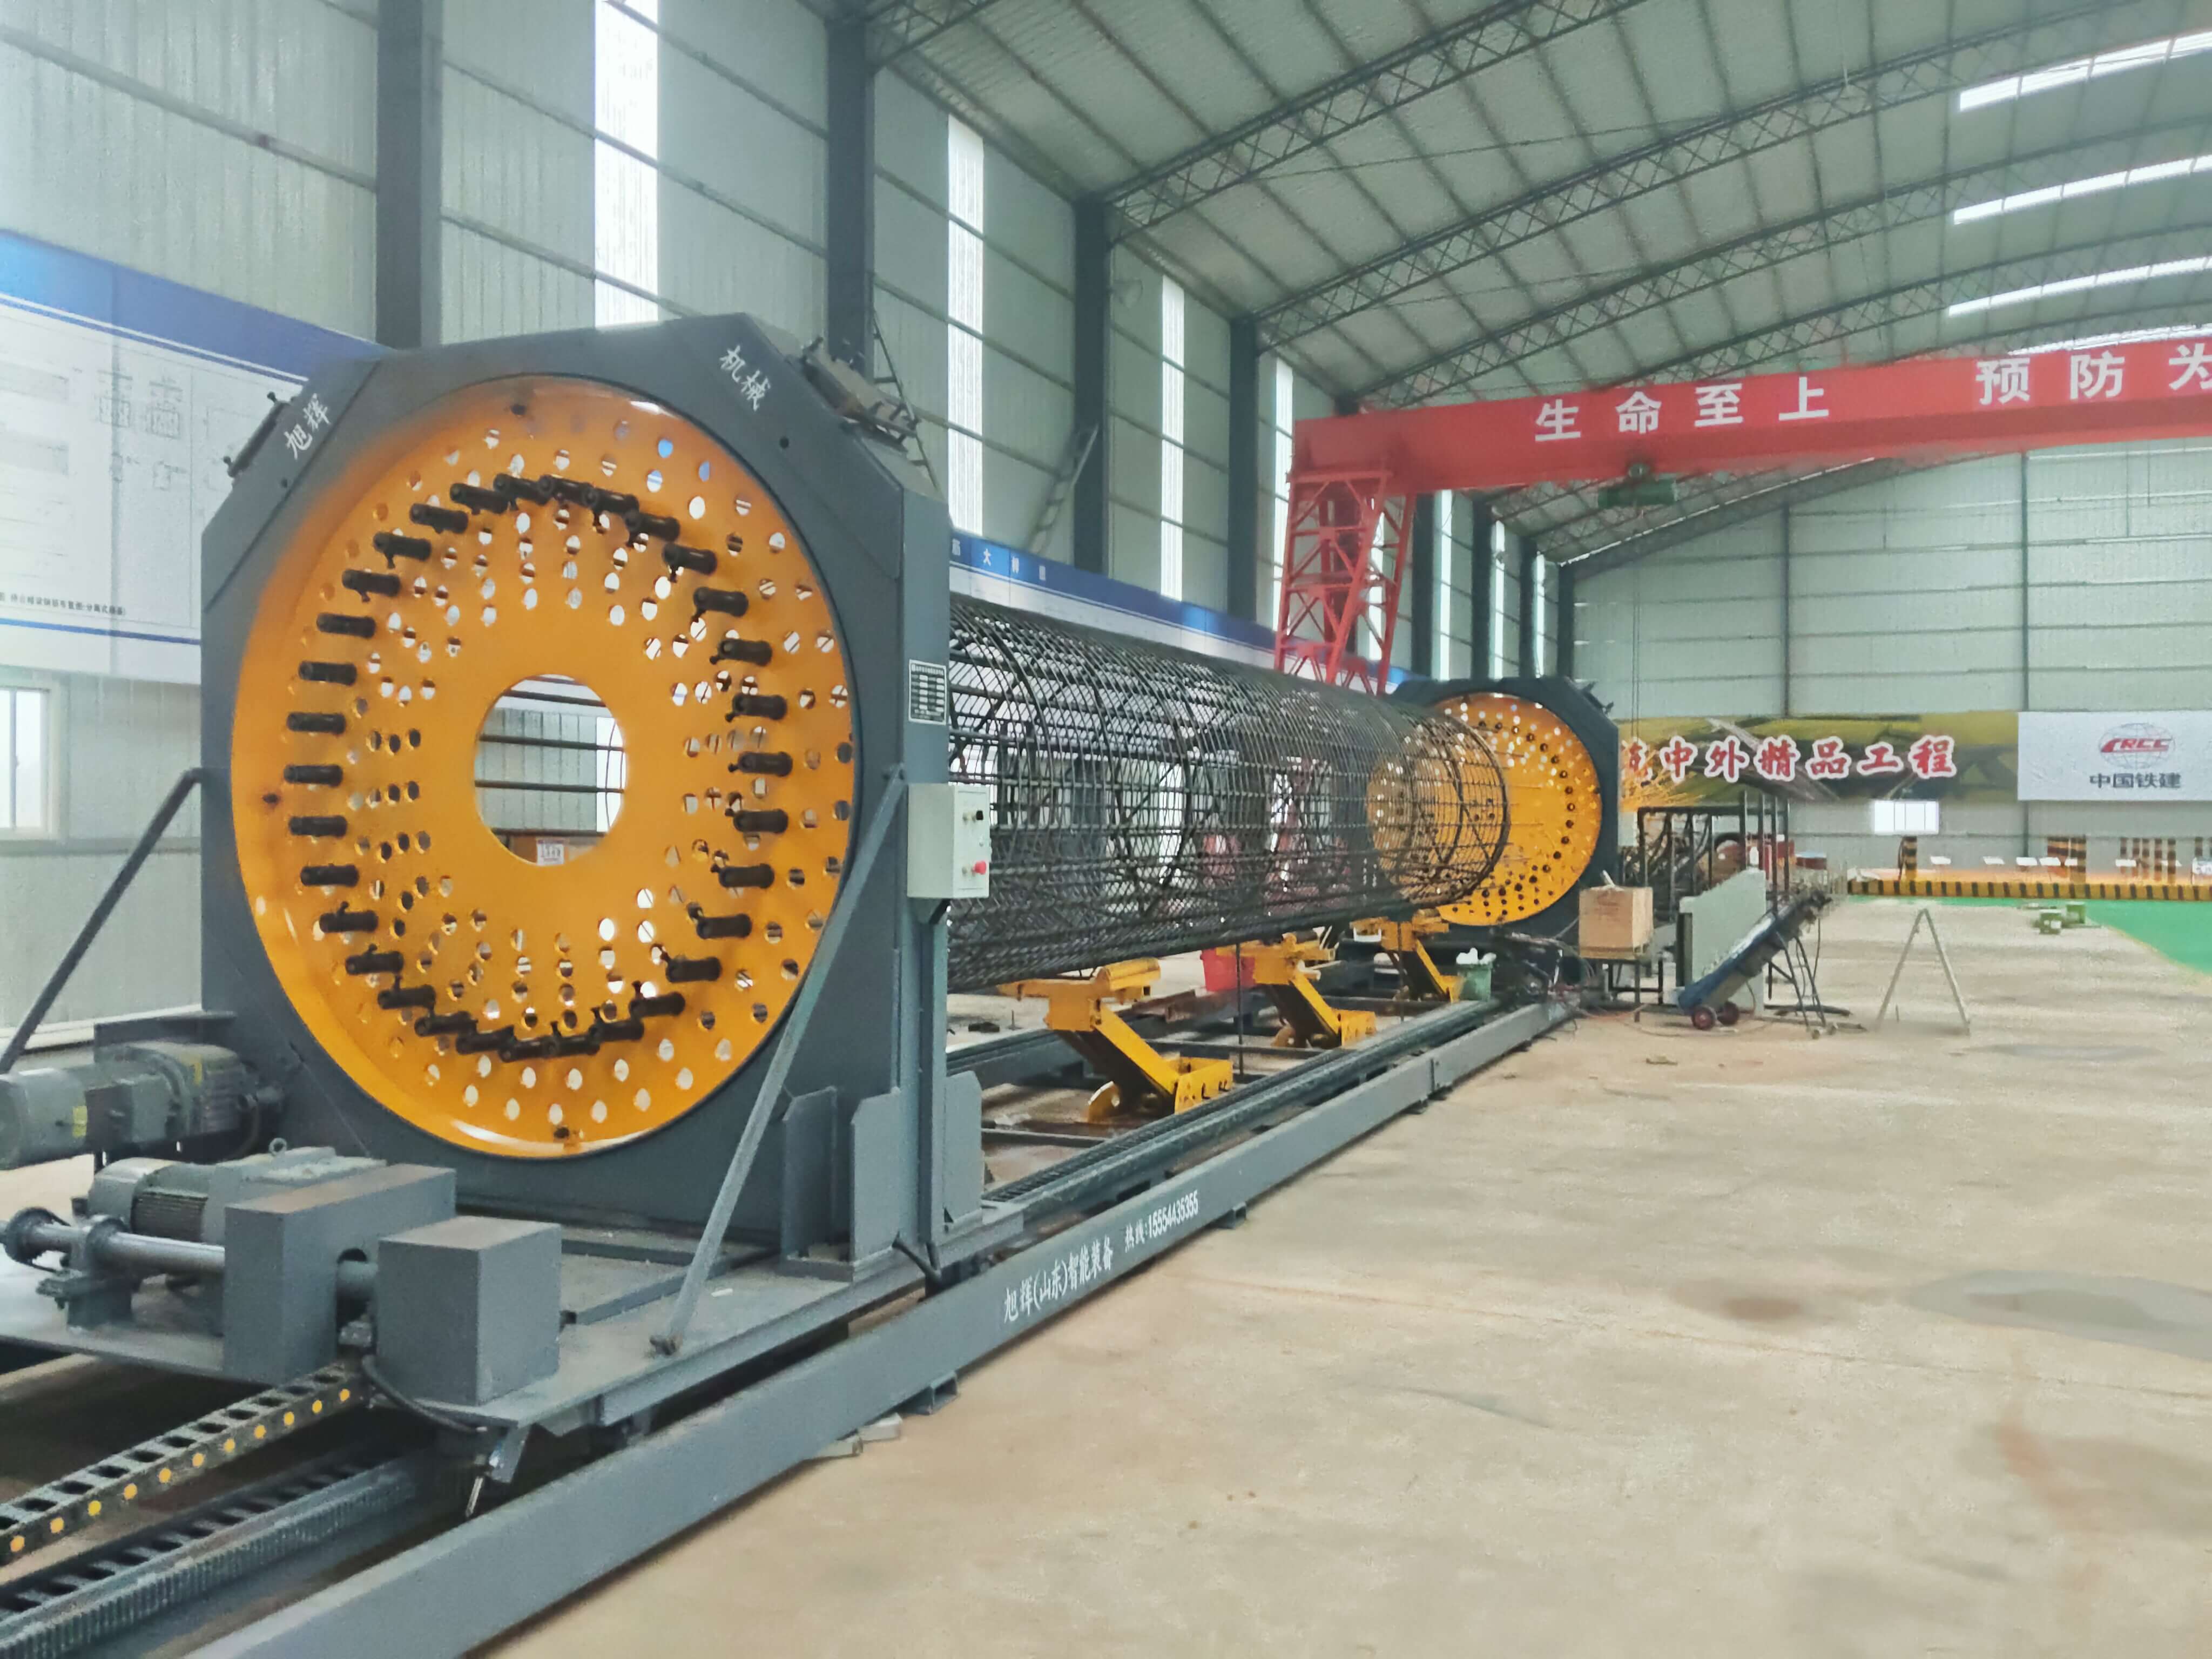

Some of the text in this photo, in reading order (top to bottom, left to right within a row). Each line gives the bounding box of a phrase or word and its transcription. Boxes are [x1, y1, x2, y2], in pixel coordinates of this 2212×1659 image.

[719, 345, 771, 411] 机械
[1535, 343, 2212, 442] 生命至上 预防为
[284, 393, 332, 460] 旭辉
[2101, 737, 2173, 753] CRCC
[2089, 772, 2181, 789] 中国铁建
[1004, 1233, 1114, 1324] 旭辉(山东)智能装备
